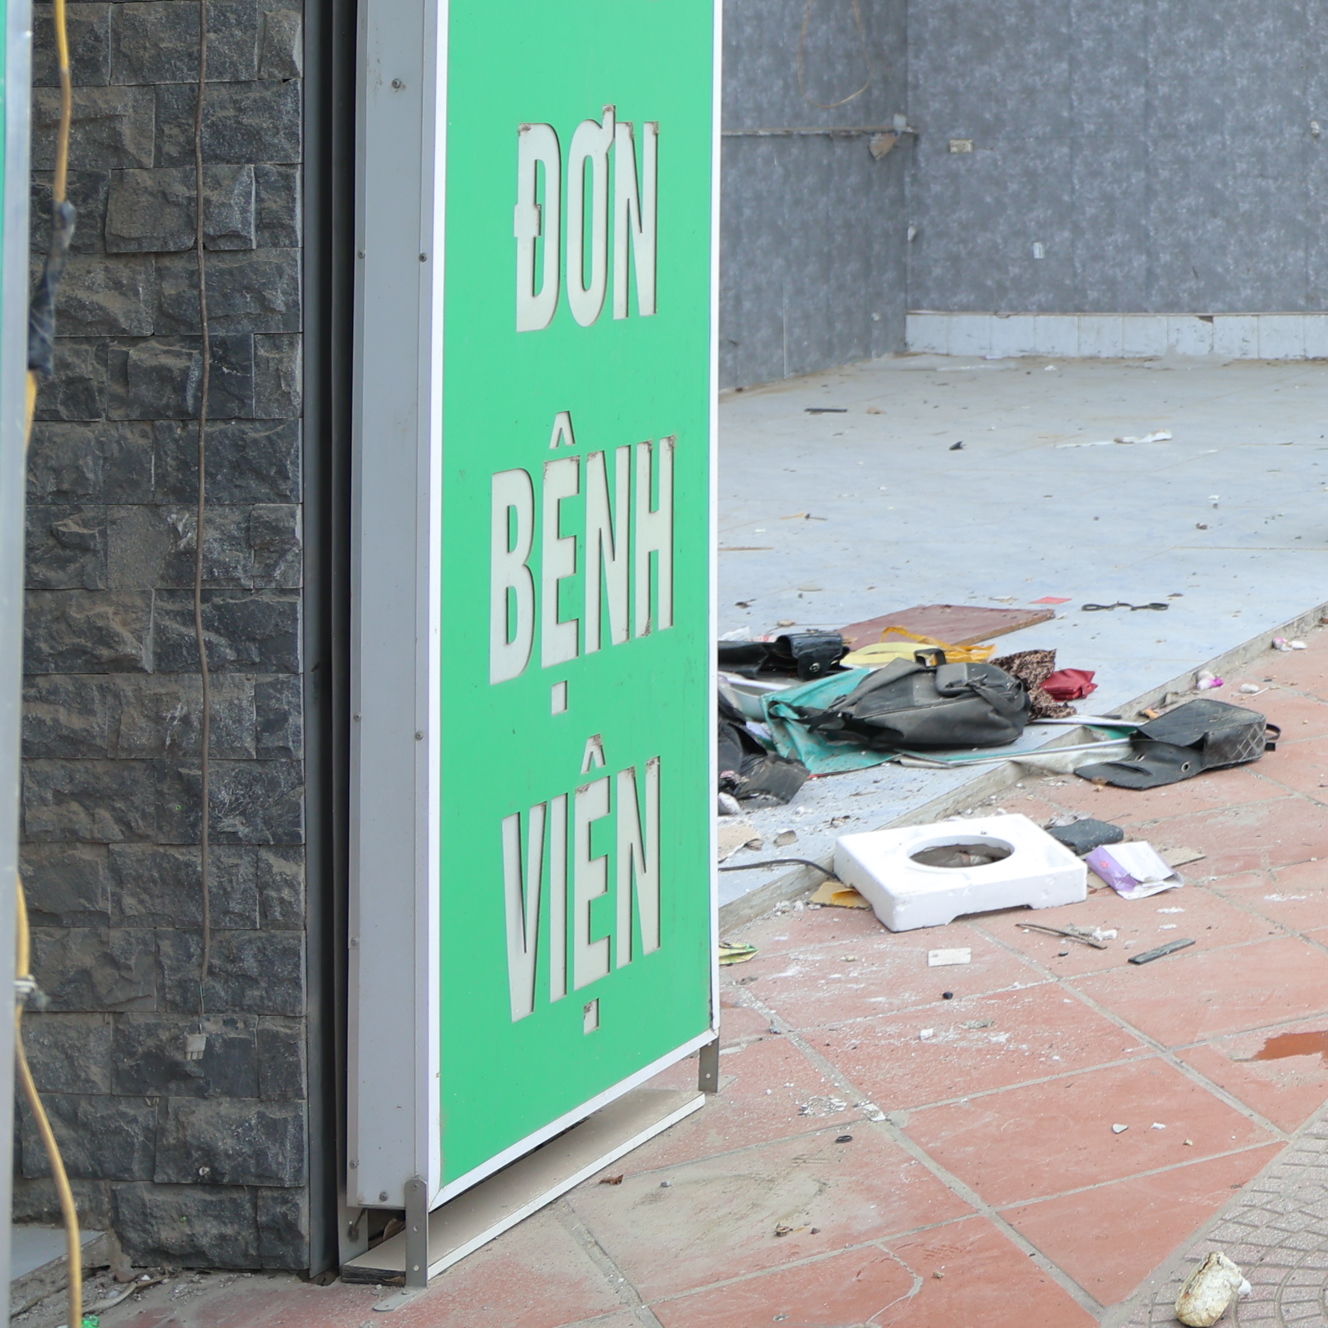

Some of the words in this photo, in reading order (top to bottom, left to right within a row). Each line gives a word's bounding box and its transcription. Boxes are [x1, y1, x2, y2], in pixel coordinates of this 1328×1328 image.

[513, 104, 659, 332] ĐƠN
[489, 410, 677, 716] BỆNH
[501, 733, 661, 1035] VIỆN
